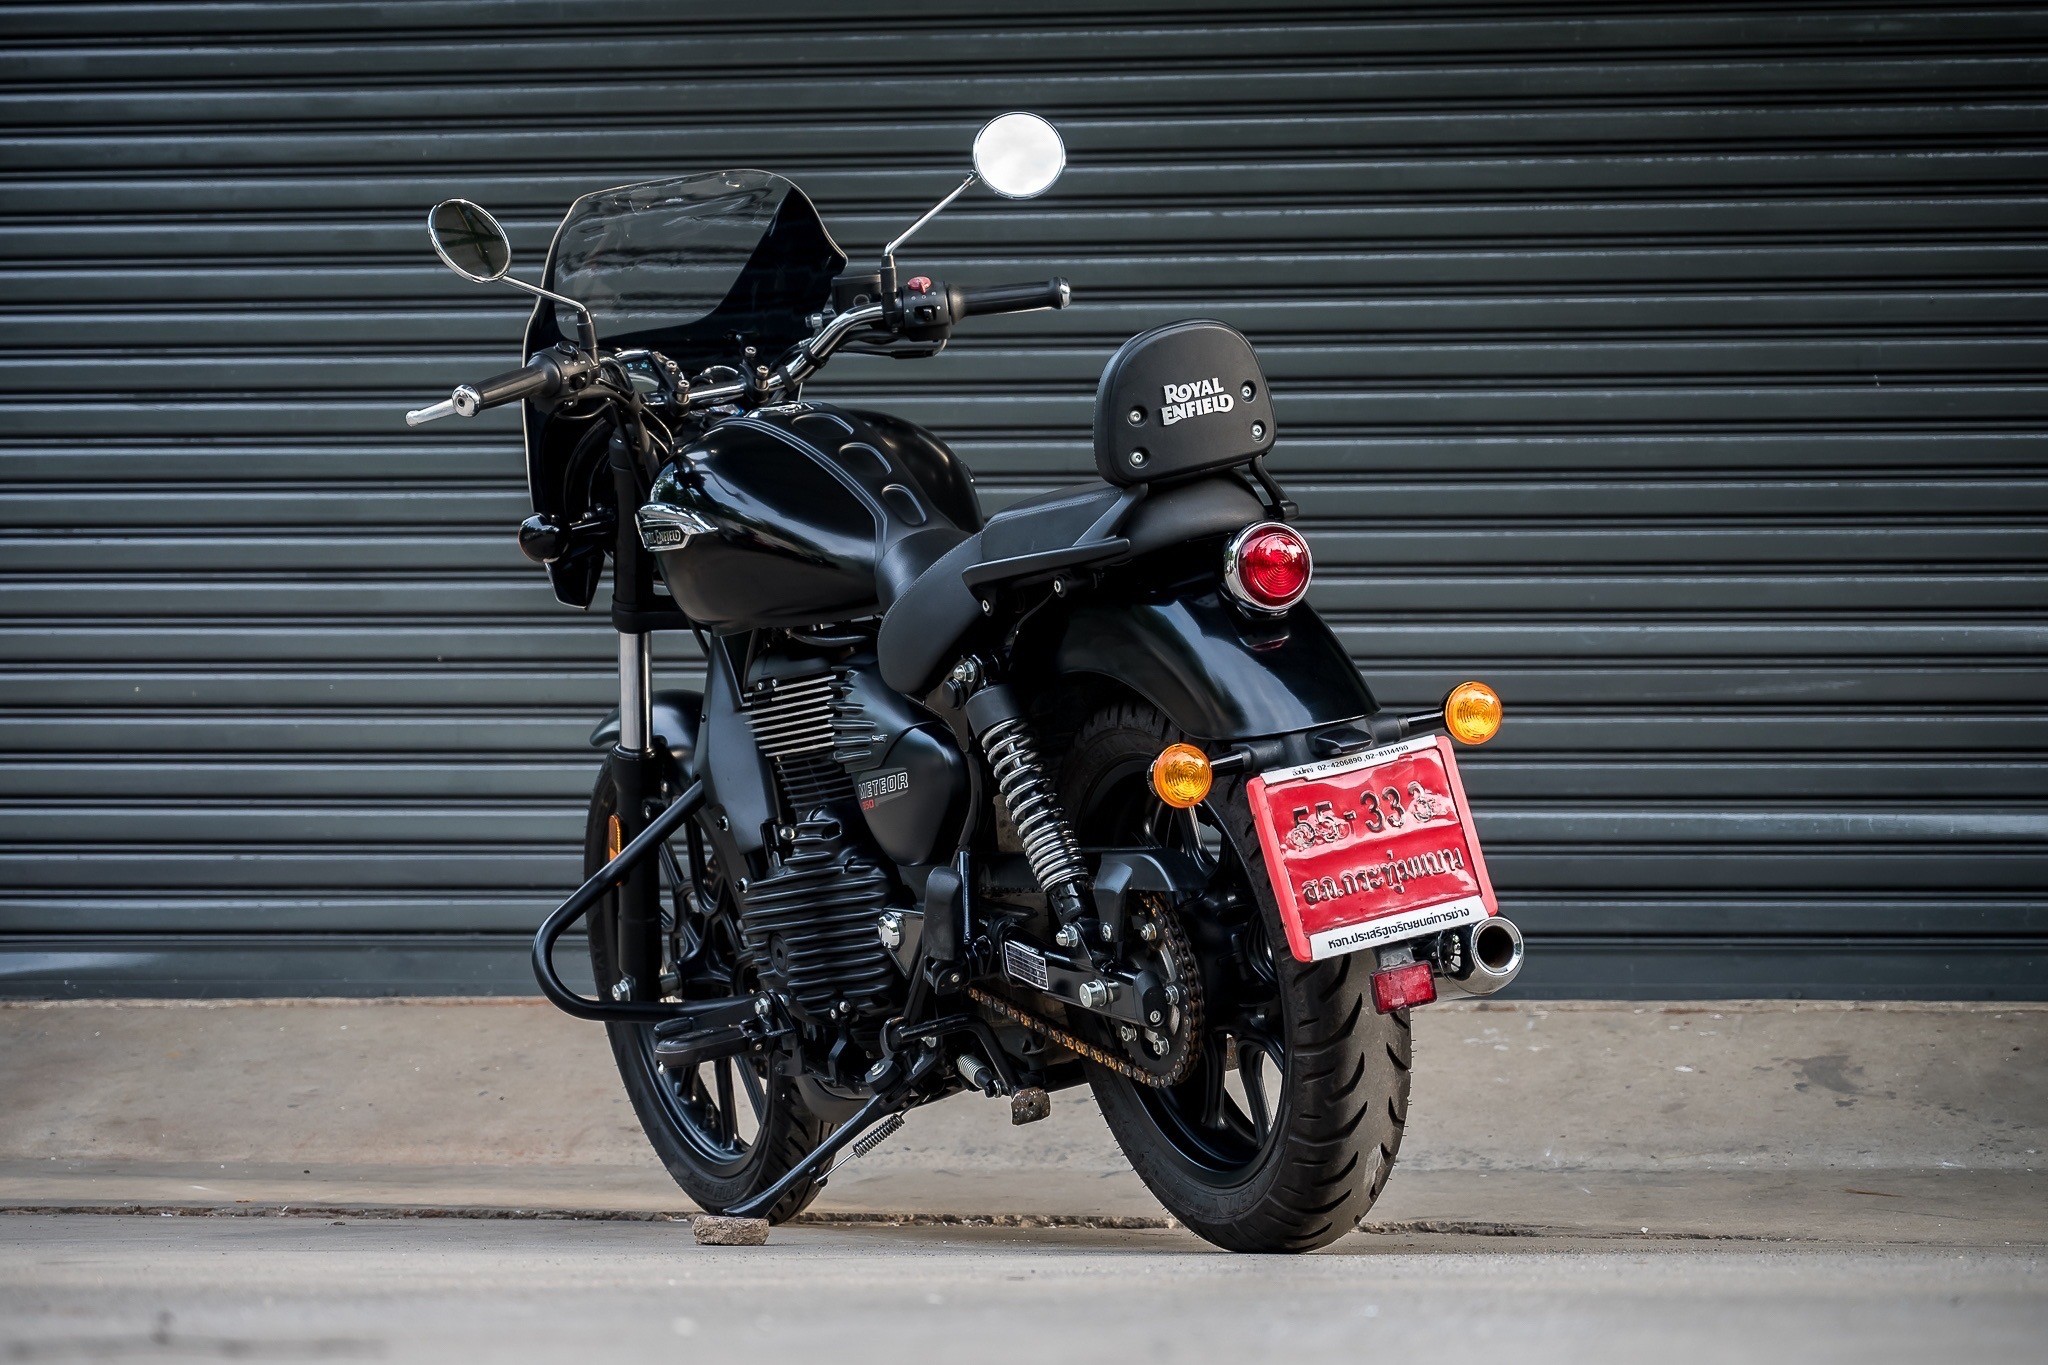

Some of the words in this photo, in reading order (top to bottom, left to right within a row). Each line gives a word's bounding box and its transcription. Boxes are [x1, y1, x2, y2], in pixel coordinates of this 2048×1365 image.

[1163, 377, 1225, 405] ROYAL
[1161, 393, 1235, 426] ENFIELD
[857, 771, 909, 800] METEOR
